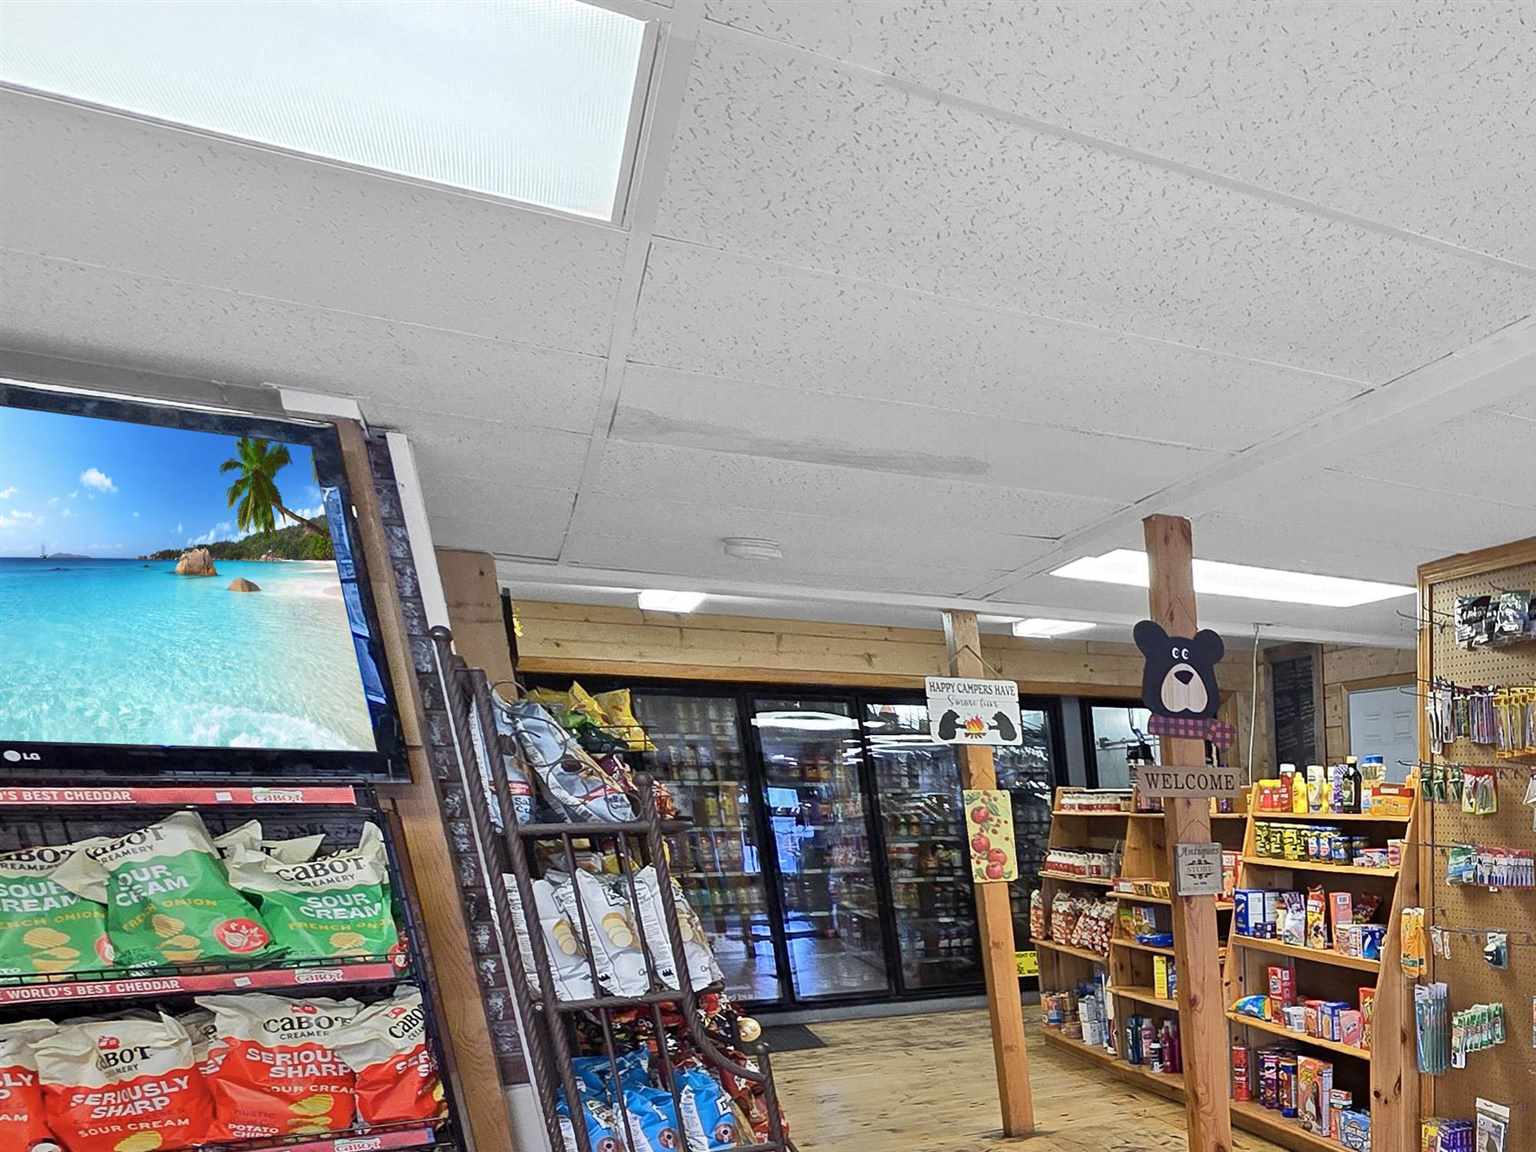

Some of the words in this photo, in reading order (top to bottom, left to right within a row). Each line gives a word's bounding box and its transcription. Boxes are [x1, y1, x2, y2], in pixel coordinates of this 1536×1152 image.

[929, 682, 955, 693] HAPPY
[956, 683, 993, 695] CAMPERS
[994, 684, 1015, 696] HAVE
[22, 751, 40, 760] LG
[1145, 773, 1235, 790] WELCOME
[23, 790, 60, 800] BEST
[65, 790, 132, 801] CHEDDAR
[307, 892, 372, 908] SOUR
[299, 902, 382, 921] CREAM
[6, 986, 72, 1000] WORLD'S
[78, 984, 111, 995] BEST
[116, 979, 180, 993] CHEDDAR
[70, 1075, 190, 1107] SERIOUSLY
[91, 1096, 172, 1119] SHARP
[78, 1125, 122, 1138] SOUR
[128, 1118, 190, 1131] CREAM
[228, 1123, 280, 1134] POTATO
